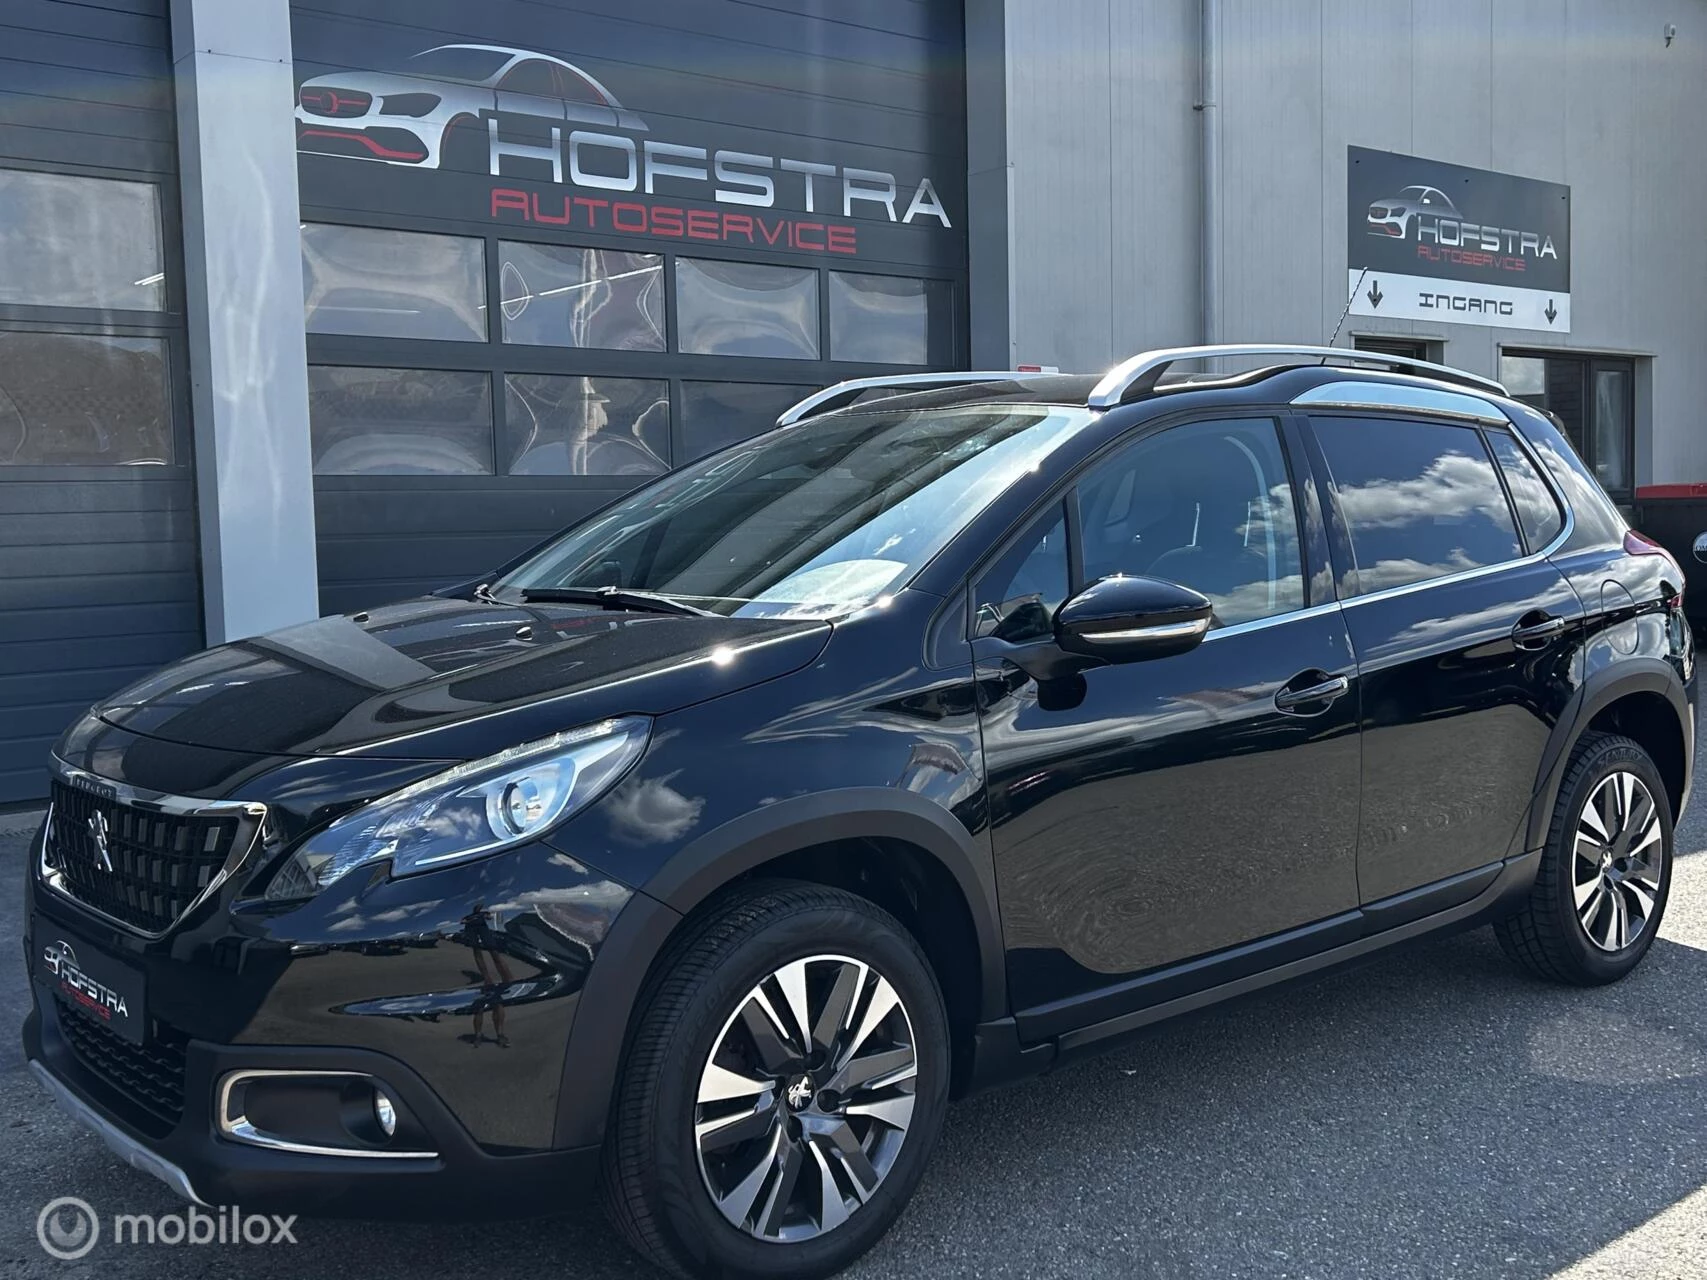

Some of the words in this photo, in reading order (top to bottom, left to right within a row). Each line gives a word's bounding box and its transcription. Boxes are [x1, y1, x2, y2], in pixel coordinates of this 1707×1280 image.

[489, 117, 952, 228] HOFSTRA
[491, 188, 857, 254] AUTOSERVICE
[1417, 215, 1558, 259] HOFSTRA
[1417, 245, 1526, 271] AUTOSERVICE
[1419, 292, 1513, 316] INGANG
[61, 961, 128, 1017] HOFSTRA
